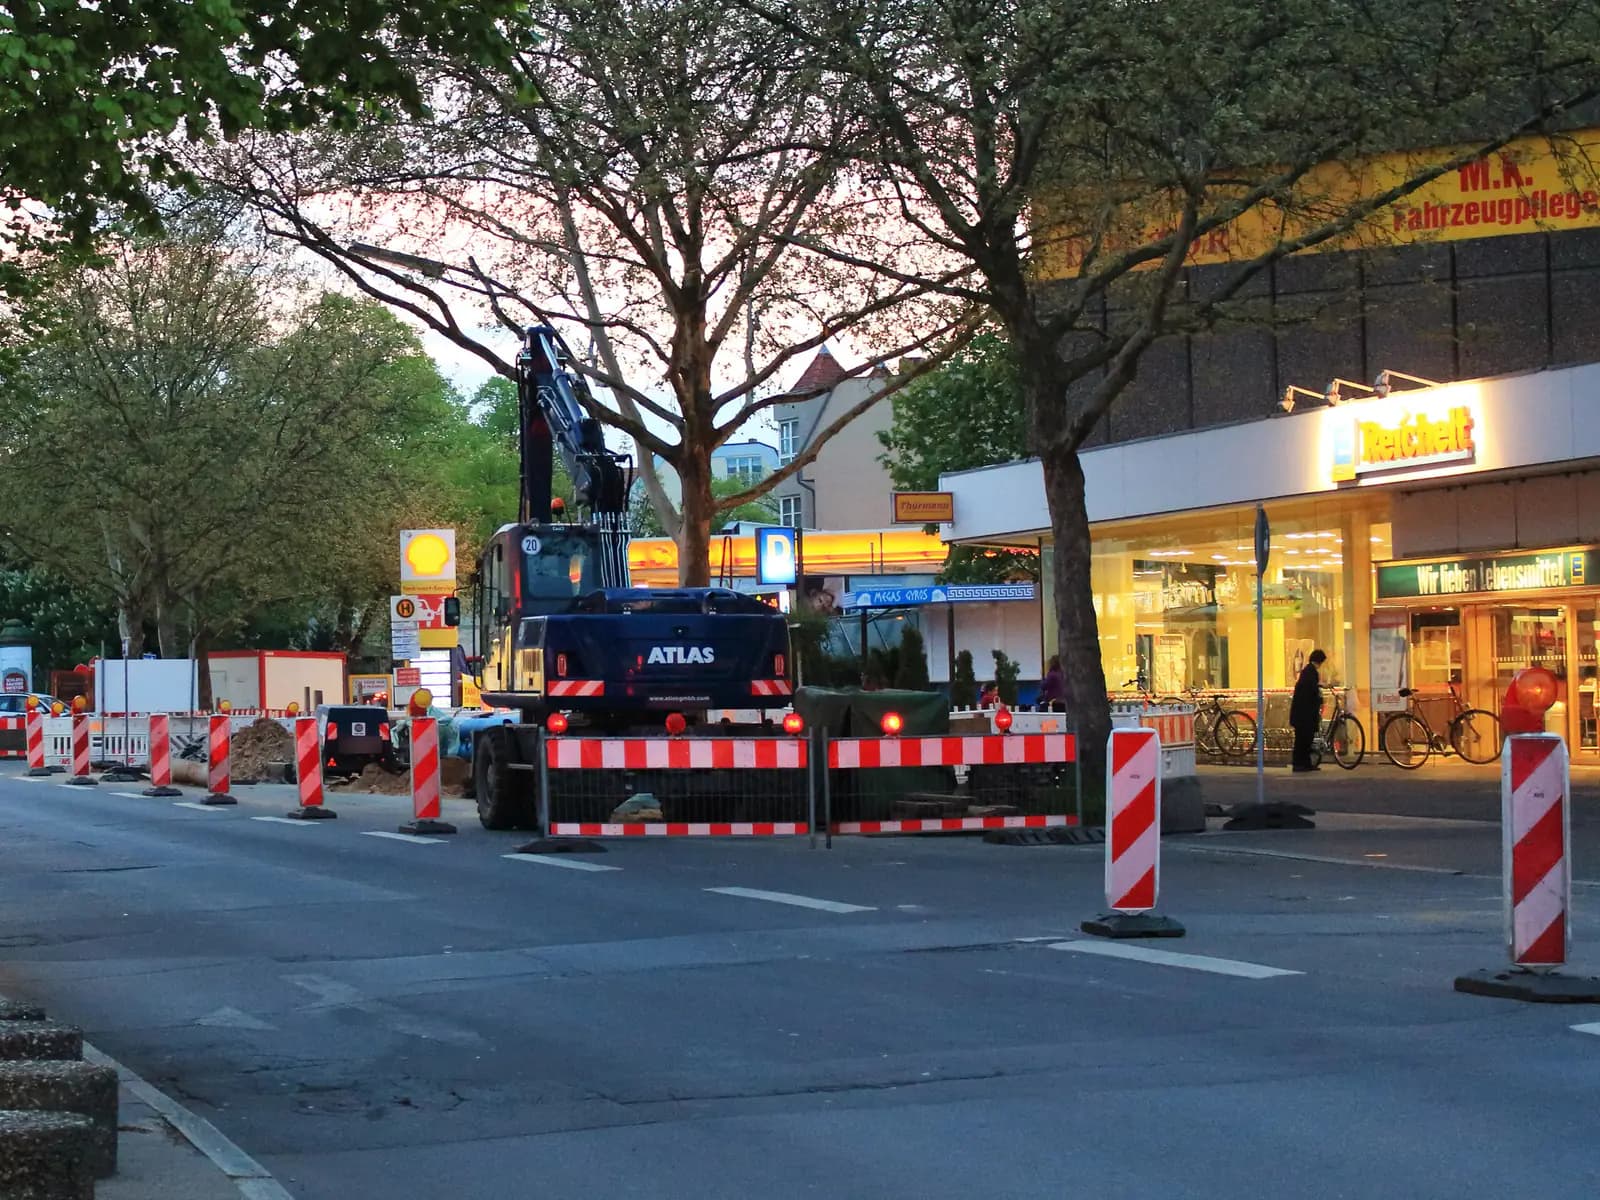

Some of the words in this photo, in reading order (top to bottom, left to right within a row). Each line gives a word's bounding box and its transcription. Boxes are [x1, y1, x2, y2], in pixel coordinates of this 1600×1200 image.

[1392, 190, 1599, 232] Fahrzeugpflege
[1359, 405, 1474, 464] Reichelt
[526, 539, 537, 551] 20
[1416, 564, 1439, 595] Wir
[1439, 562, 1477, 593] lieben
[647, 646, 715, 664] ATLAS
